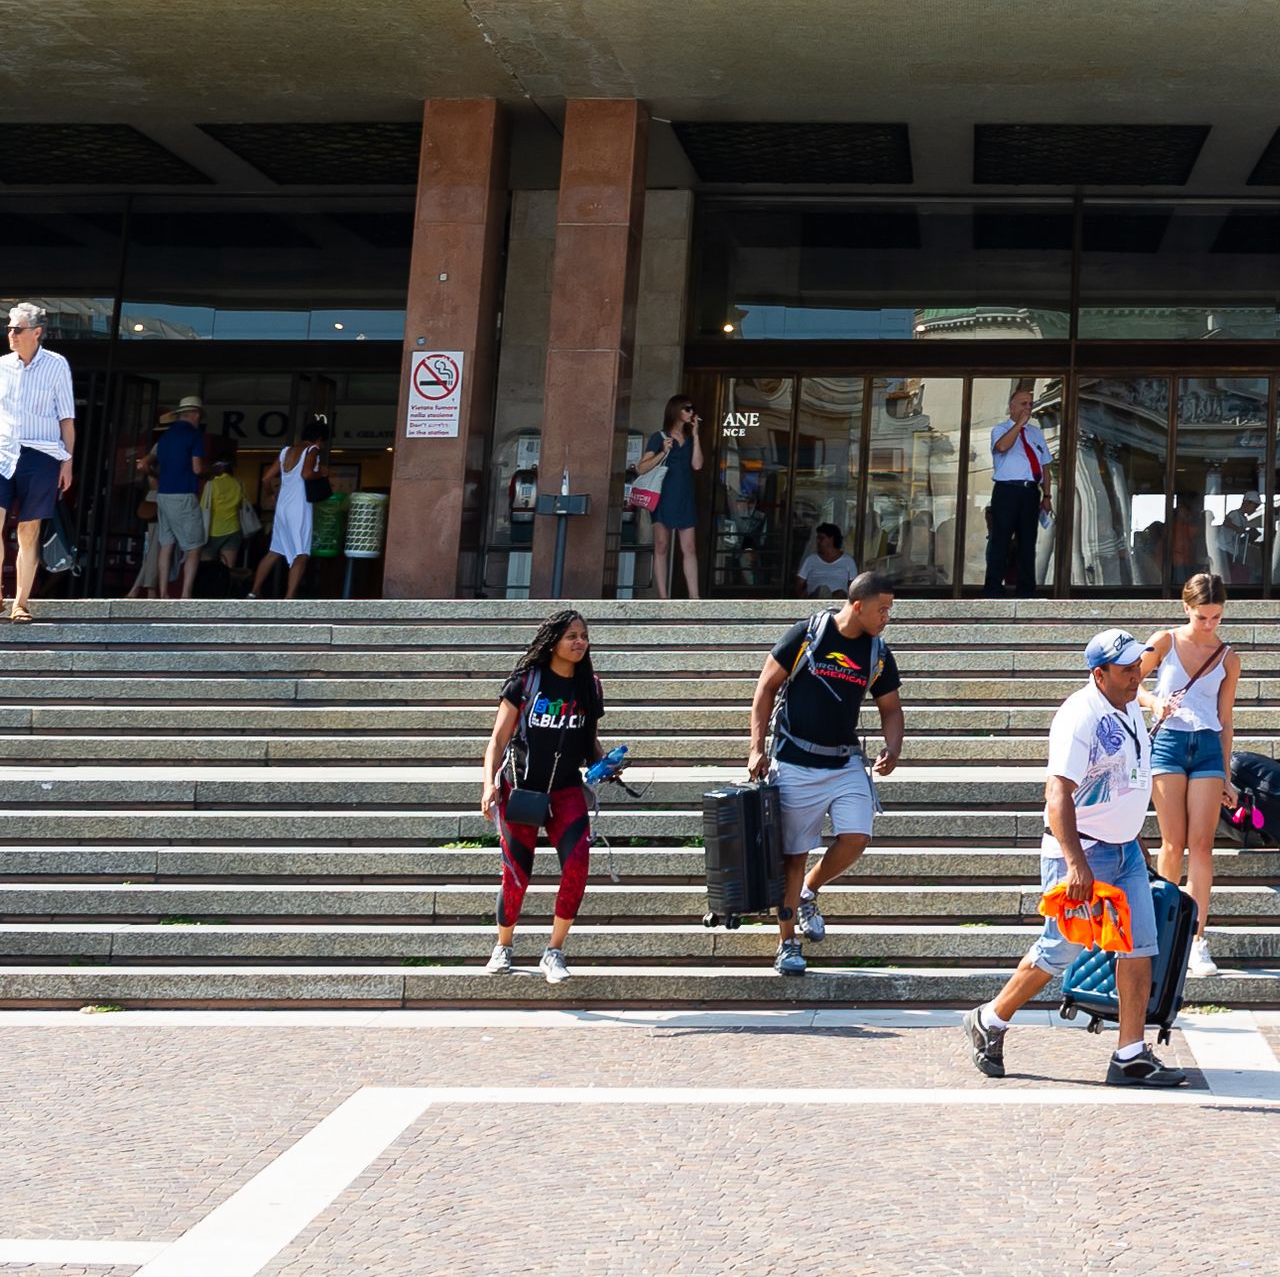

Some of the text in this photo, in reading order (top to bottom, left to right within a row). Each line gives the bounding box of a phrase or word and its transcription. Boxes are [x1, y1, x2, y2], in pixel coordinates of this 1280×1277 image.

[722, 412, 760, 427] ANE
[723, 428, 746, 437] NCE
[814, 662, 855, 675] IRCUIT
